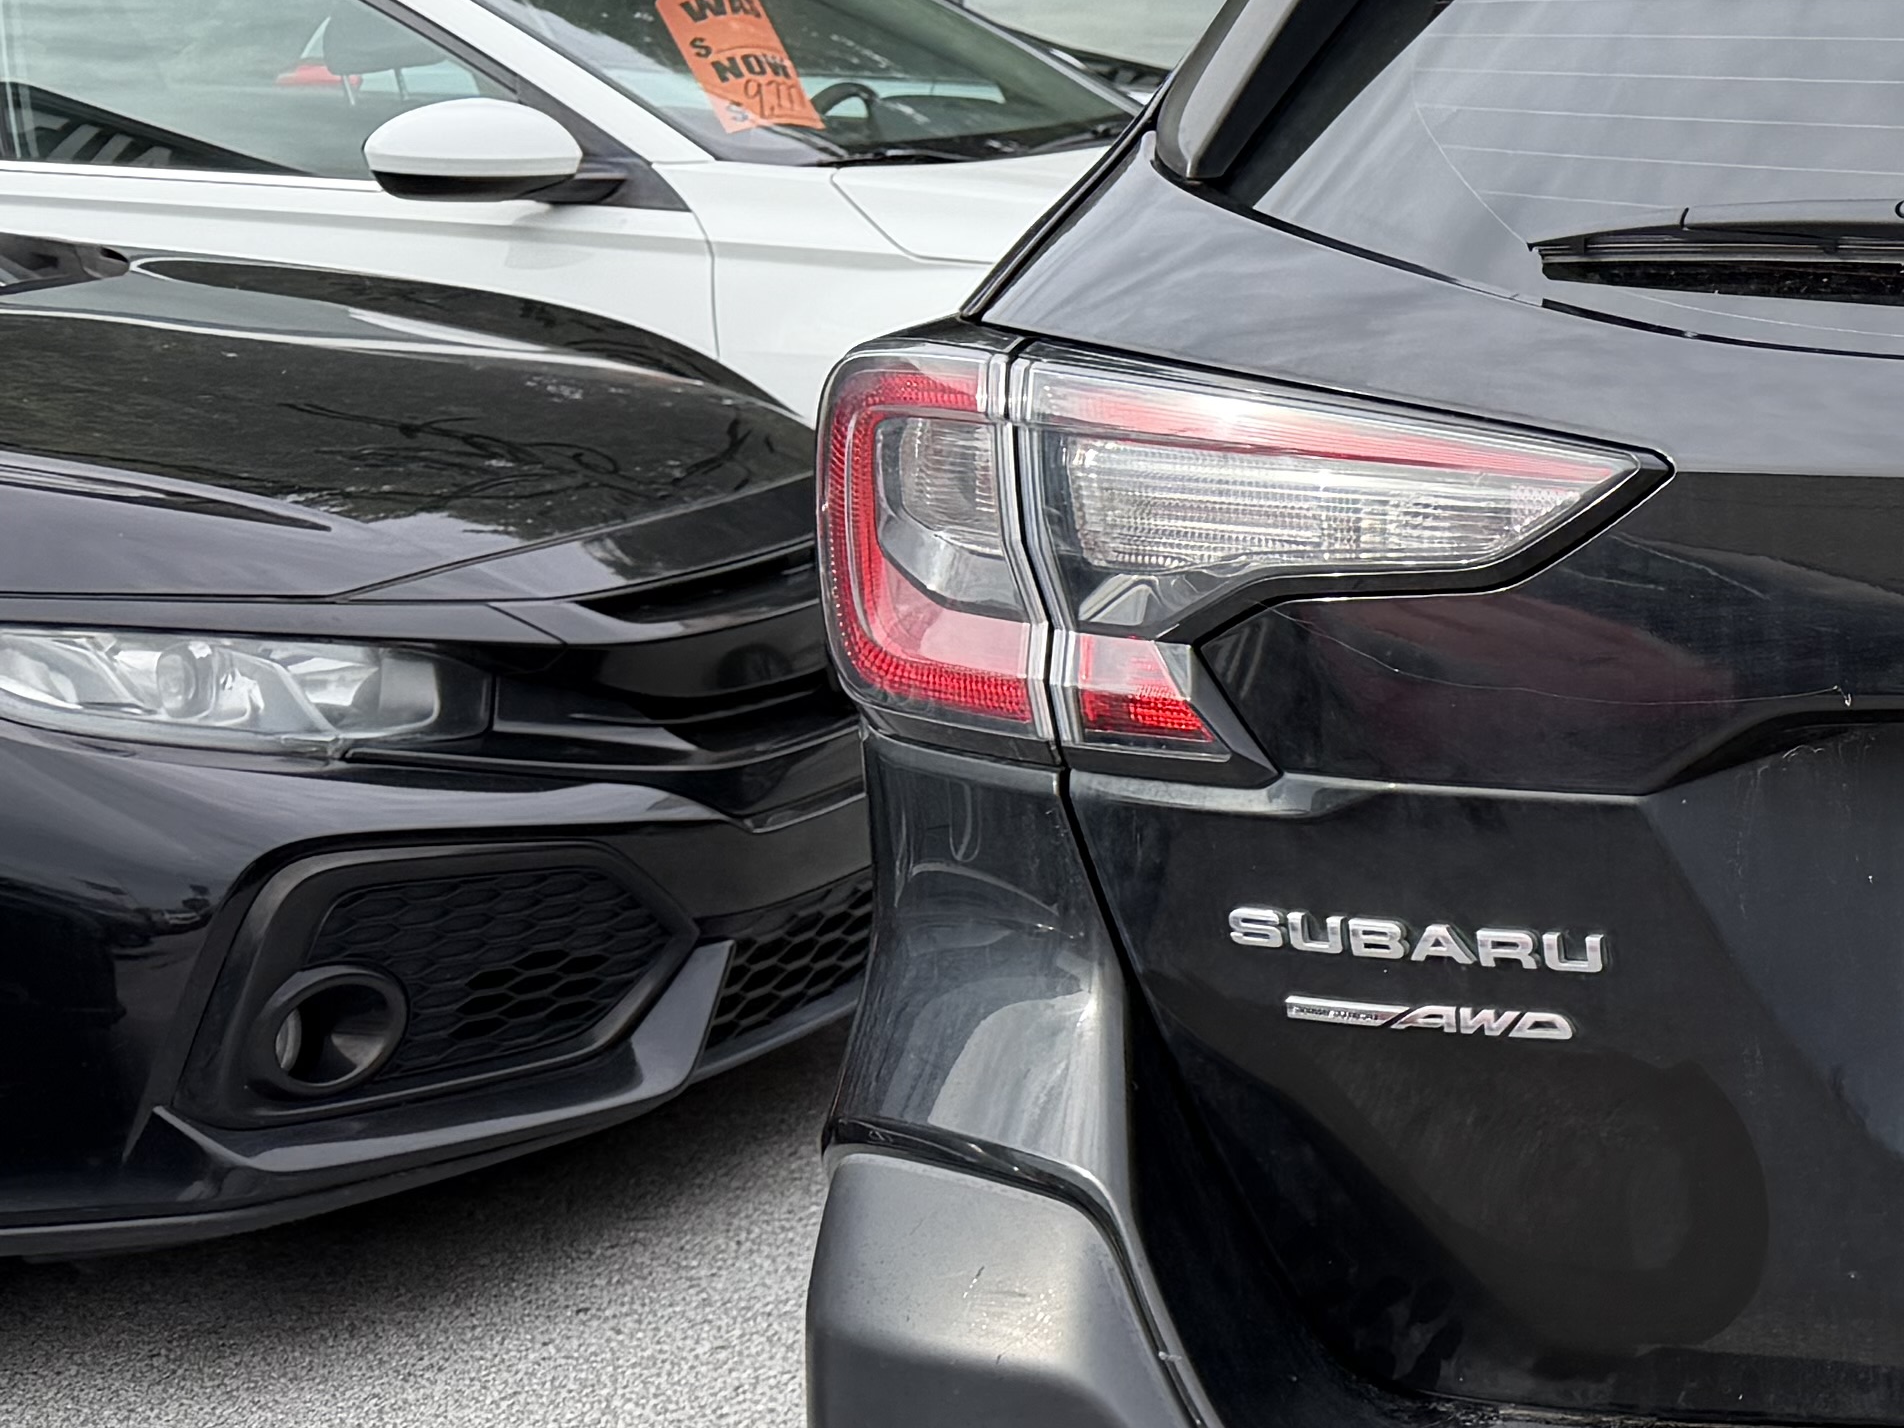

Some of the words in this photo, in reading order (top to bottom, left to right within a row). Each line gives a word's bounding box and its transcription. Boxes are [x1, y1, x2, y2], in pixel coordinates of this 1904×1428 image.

[711, 53, 792, 84] NOW
[1228, 906, 1604, 973] SUBARU
[1390, 1004, 1577, 1040] AWD
